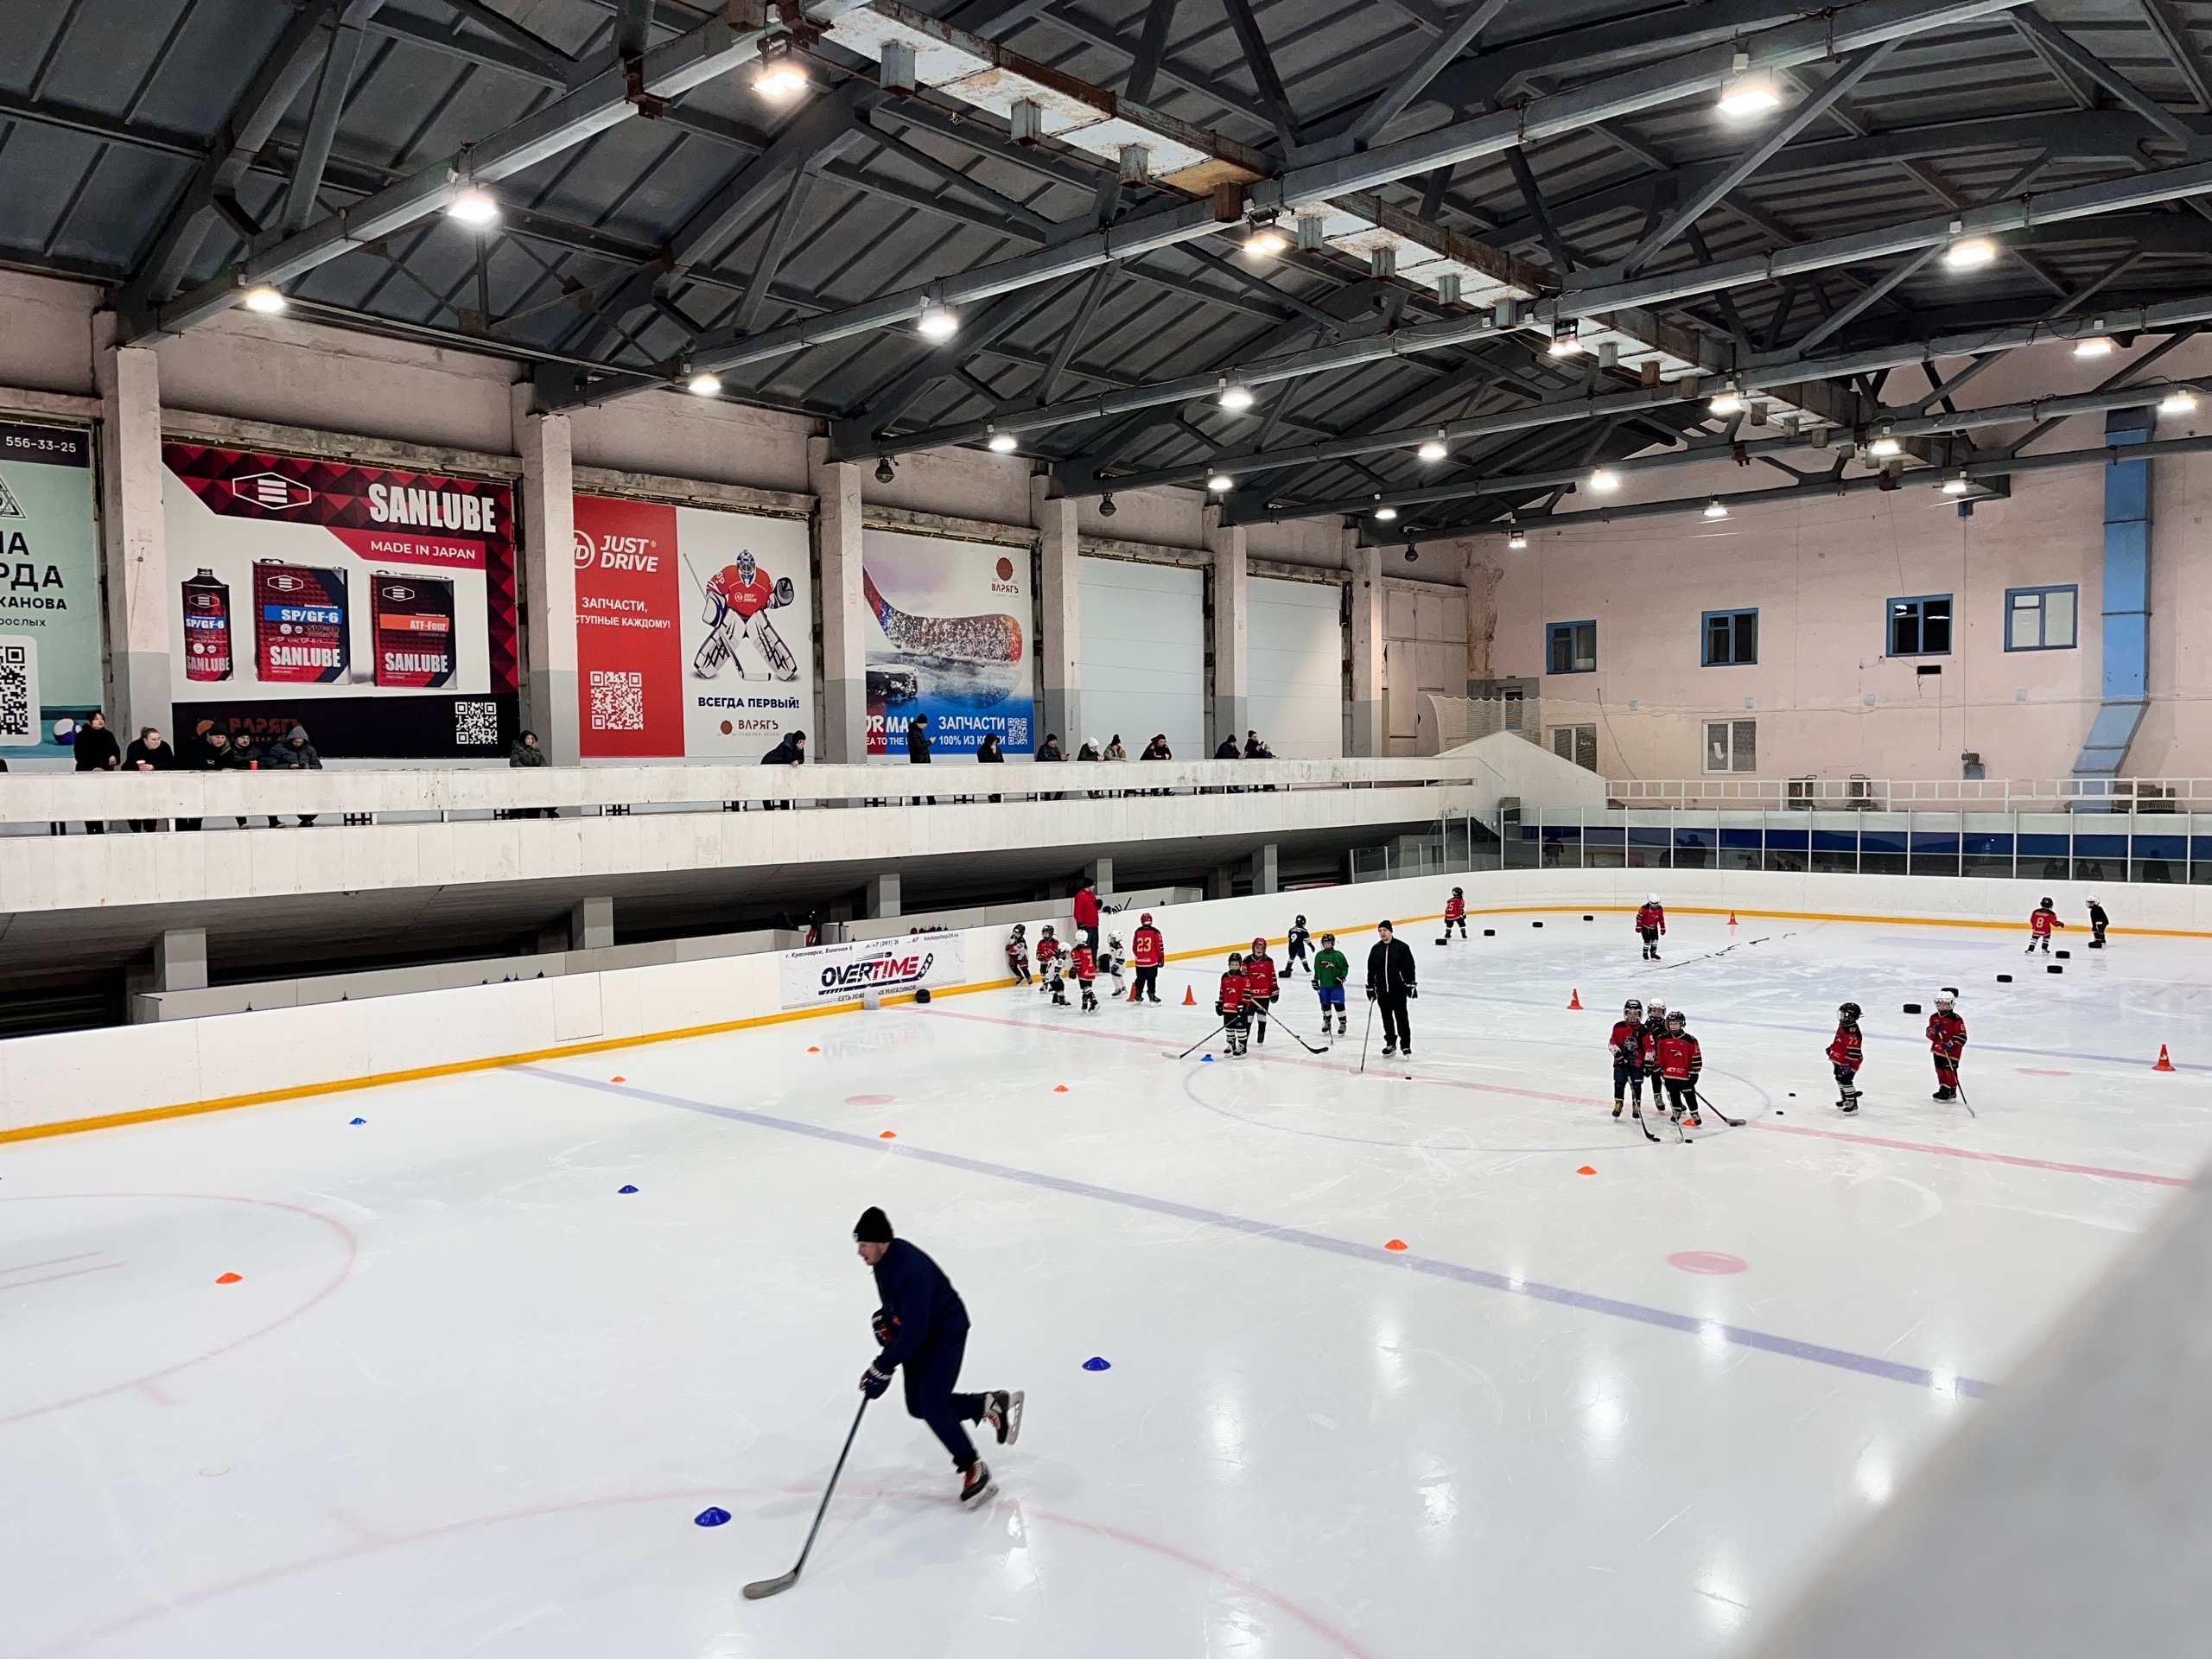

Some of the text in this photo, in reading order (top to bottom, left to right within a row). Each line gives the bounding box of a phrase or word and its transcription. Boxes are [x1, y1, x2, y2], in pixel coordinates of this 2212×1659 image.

[5, 436, 76, 453] 556-33-25
[368, 483, 496, 533] SANLUBE
[371, 540, 475, 560] MADE IN JAPAN
[600, 535, 649, 555] JUST
[601, 552, 658, 572] DRIVE
[582, 597, 648, 613] ЗАПЧАСТИ,
[281, 609, 339, 623] SP/GF-6
[186, 619, 225, 629] SP/GF-6
[410, 620, 447, 631] ATF-Four
[622, 618, 671, 629] КАЖДОМУ!
[187, 655, 231, 671] SANLUBE
[270, 645, 340, 667] SANLUBE
[385, 652, 448, 672] SANLUBE
[698, 696, 799, 709] ВСЕГДА ПЕРВЫЙ!
[938, 715, 1006, 730] ЗАПЧАСТИ
[877, 736, 888, 746] TO
[889, 736, 905, 746] THE
[938, 734, 962, 746] 100%
[963, 735, 976, 746] ИЗ
[2036, 917, 2044, 928] 8
[1136, 938, 1152, 952] 23
[1291, 933, 1298, 943] 9
[791, 950, 824, 958] Красноярск,
[821, 957, 919, 988] OVERTIME
